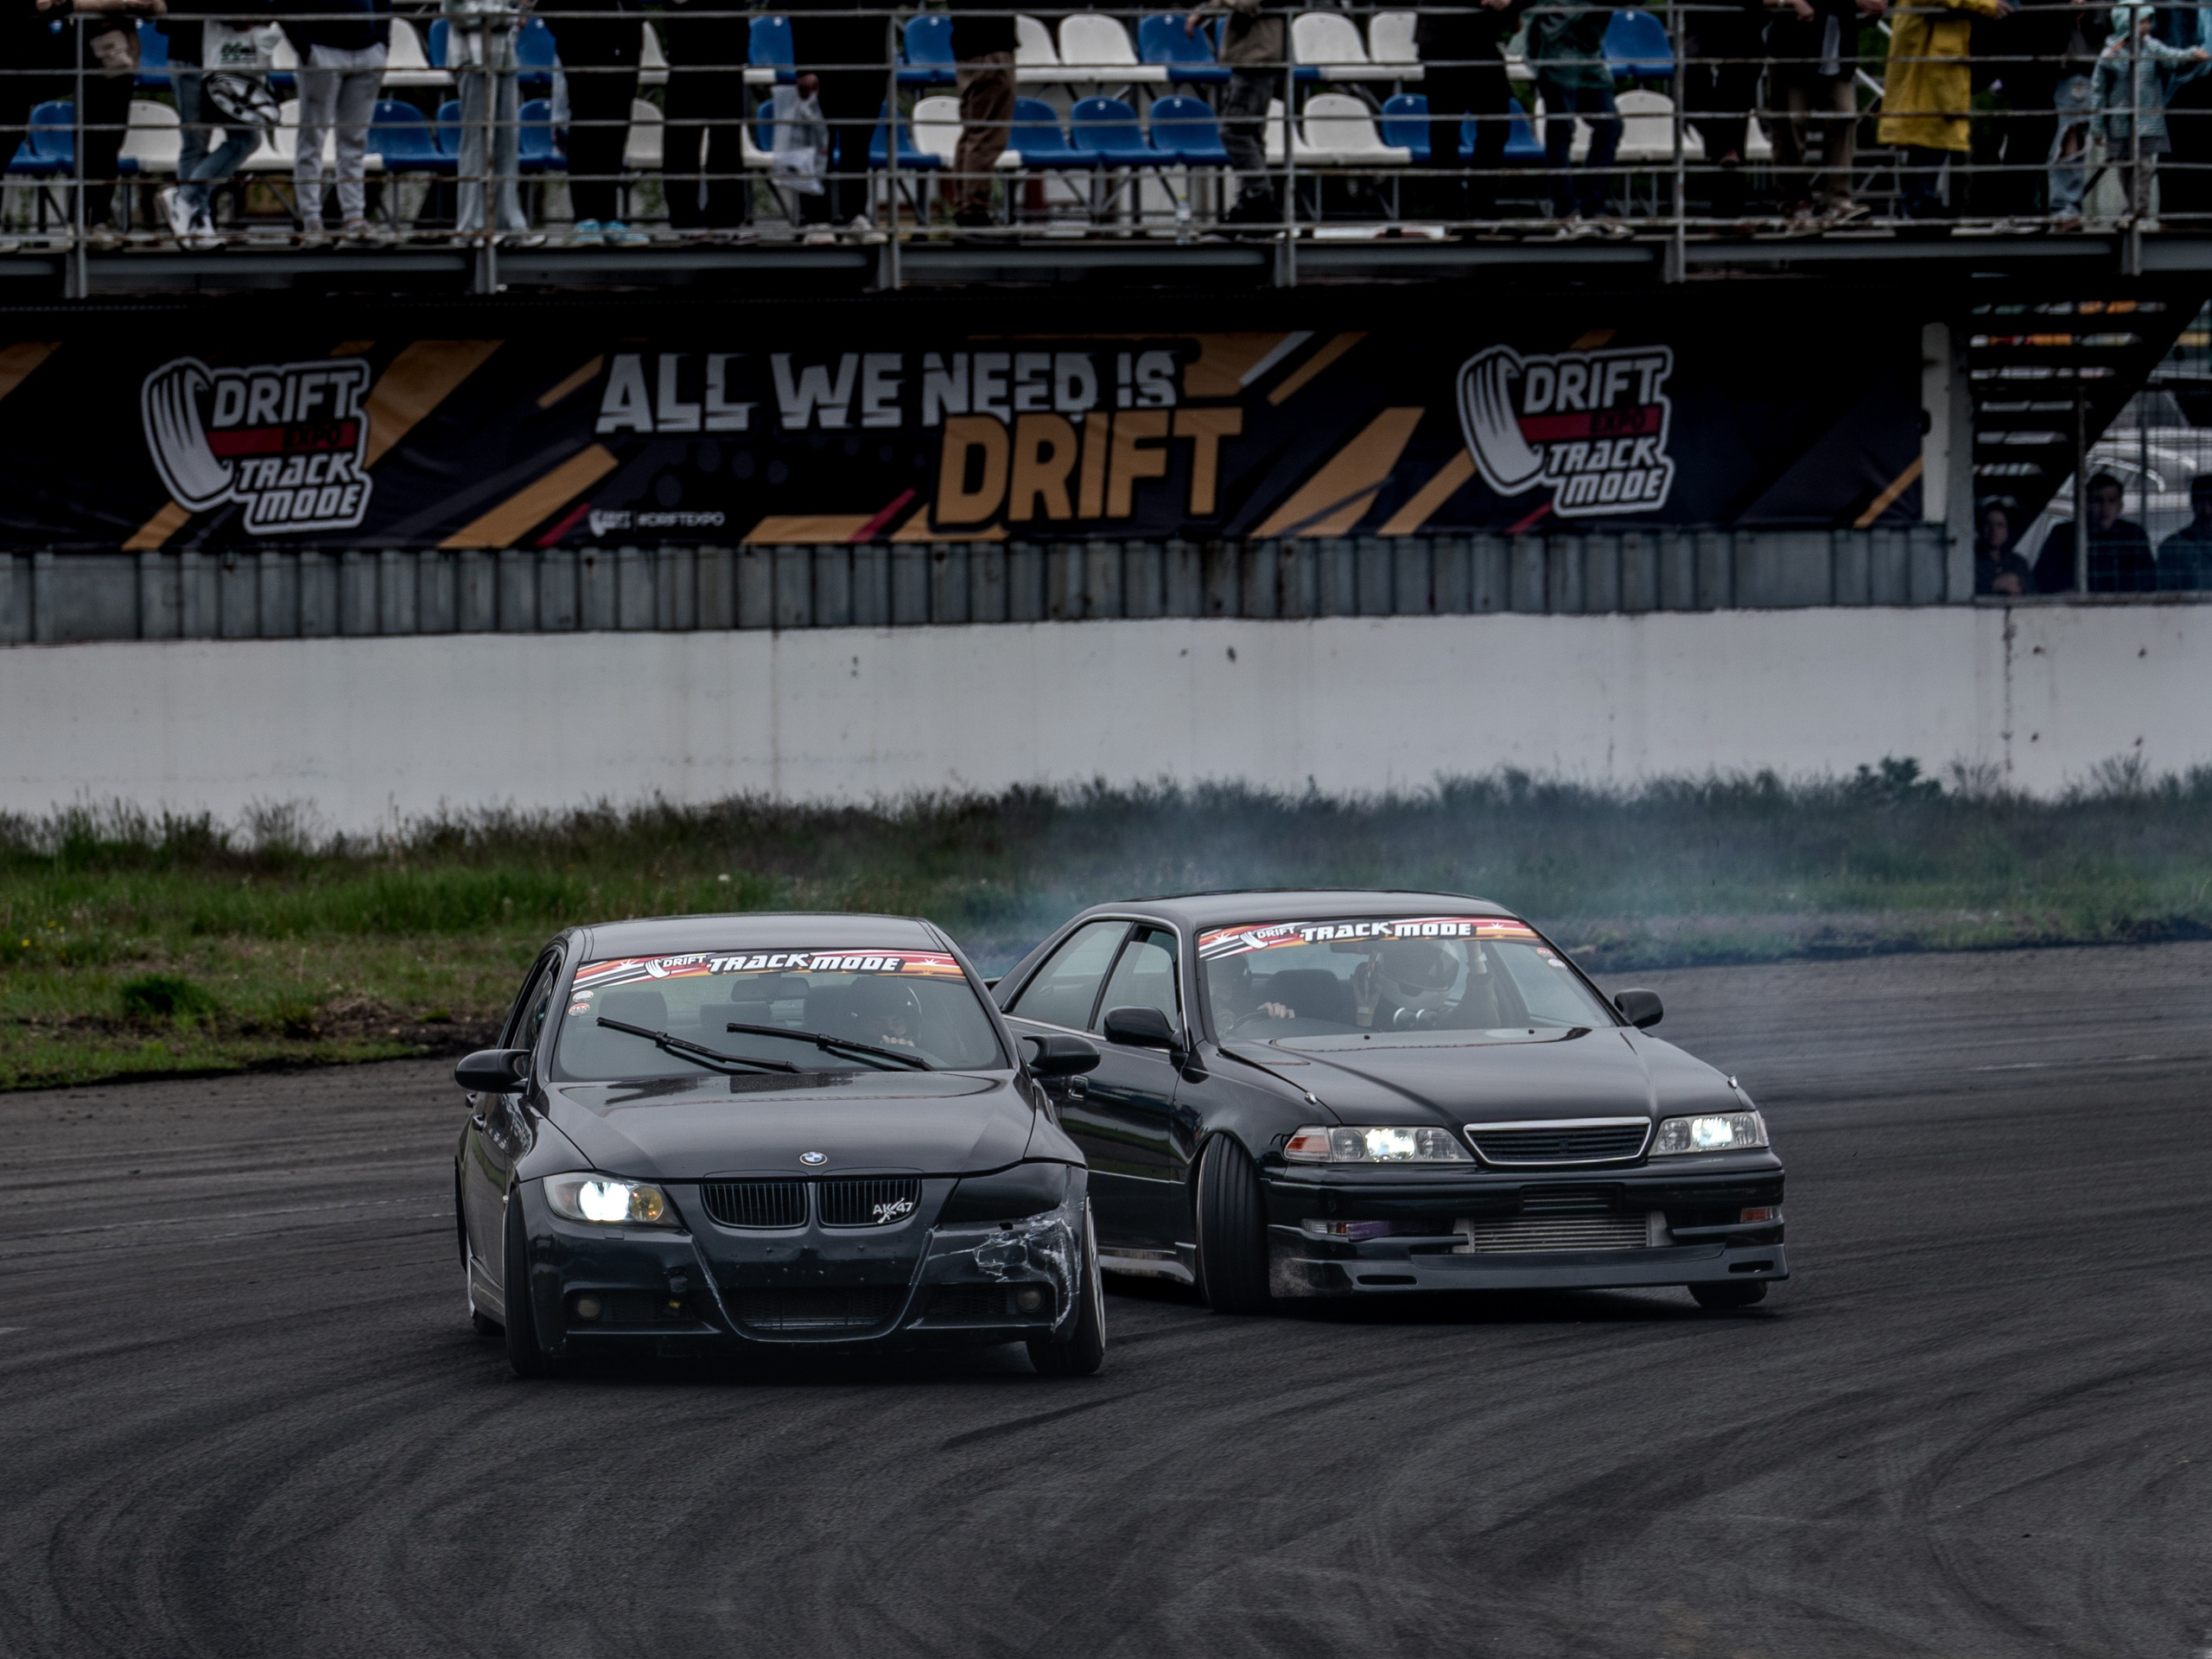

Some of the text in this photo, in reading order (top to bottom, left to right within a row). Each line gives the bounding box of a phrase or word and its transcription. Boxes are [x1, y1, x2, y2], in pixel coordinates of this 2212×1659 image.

[213, 372, 360, 427] DRIFT
[594, 350, 1177, 433] ALL WE NEED IS
[1524, 359, 1663, 413] DRIFT
[239, 453, 353, 491] TRACK
[935, 407, 1243, 525] DRIFT
[1549, 438, 1656, 474] TRACK
[254, 486, 361, 522] MODE
[1565, 469, 1662, 505] MODE
[1256, 925, 1295, 939] DRIFT
[663, 955, 707, 968] DRIFT
